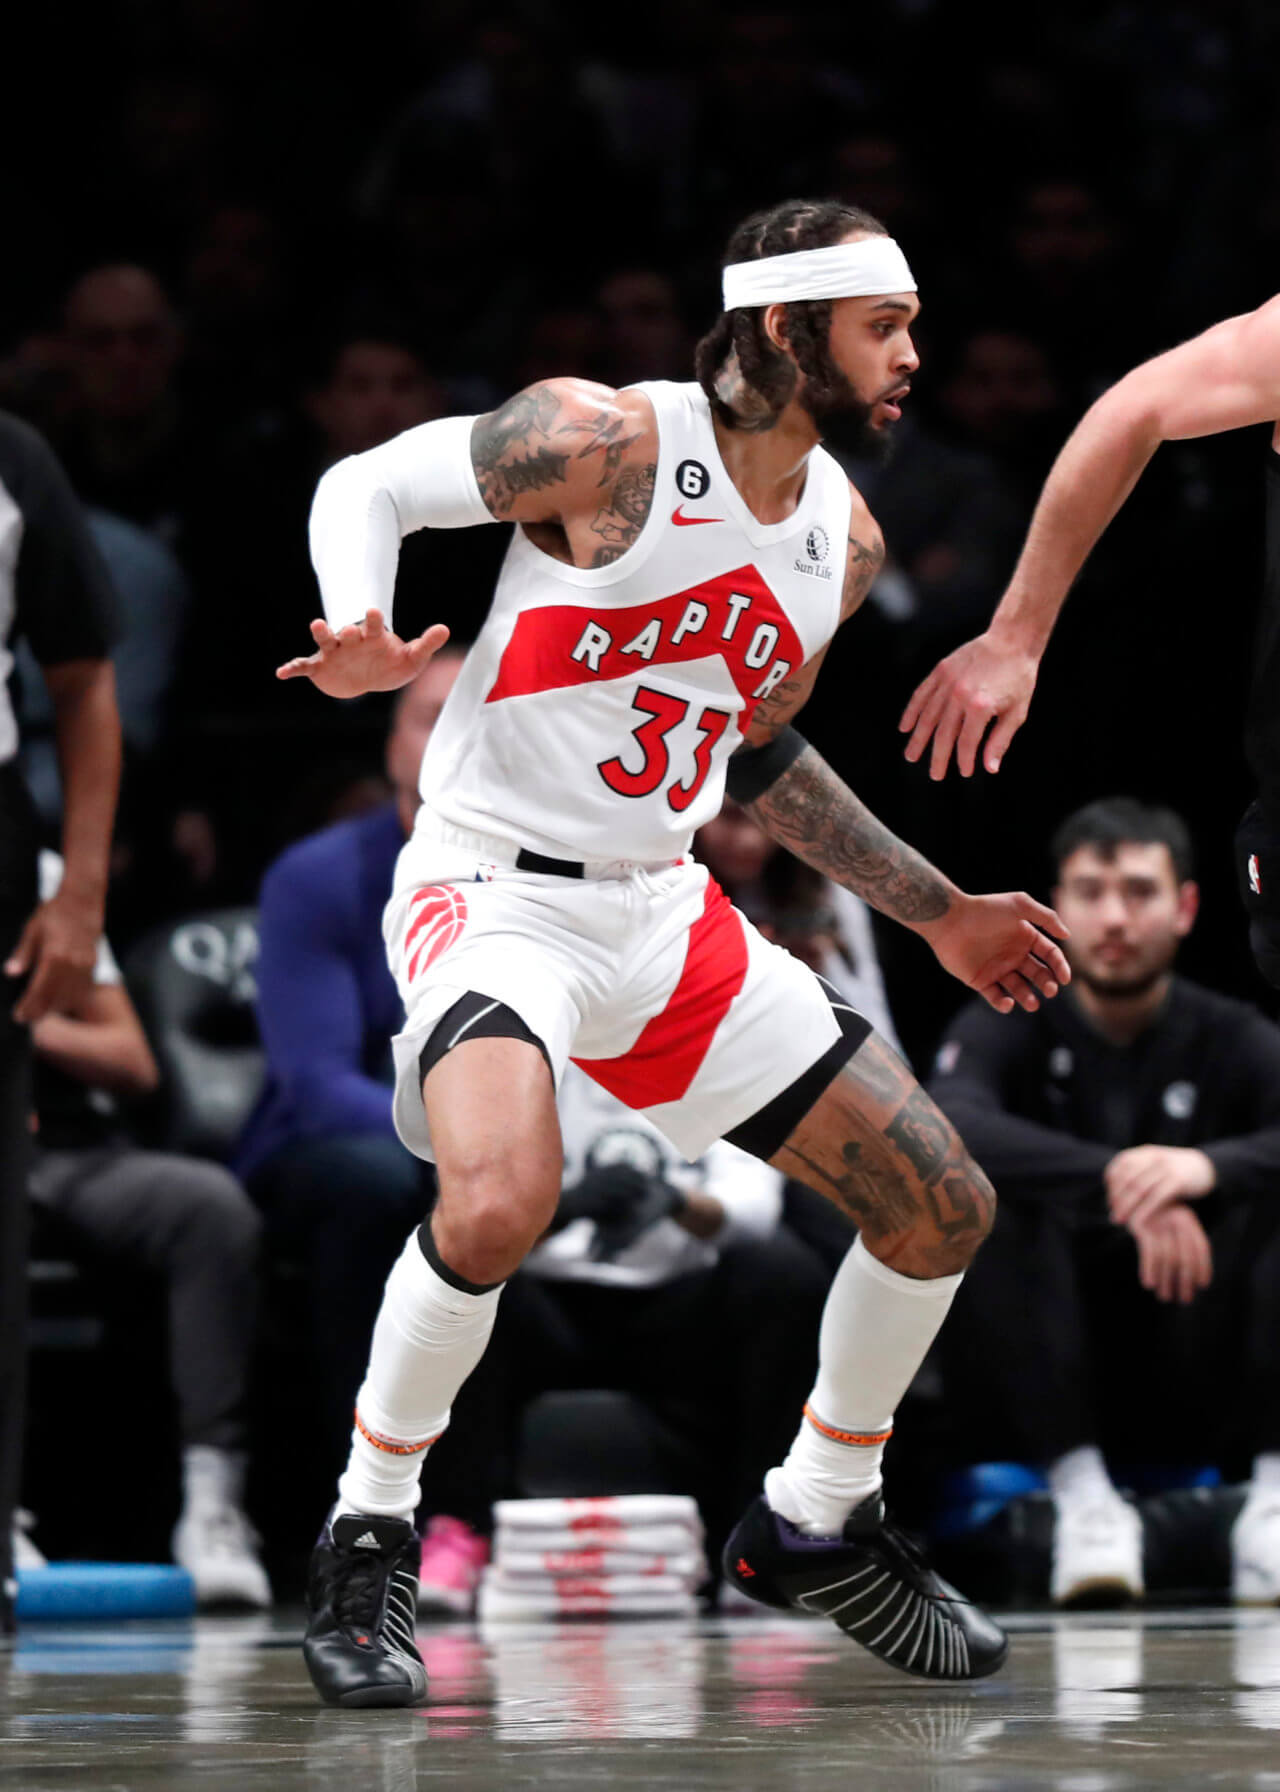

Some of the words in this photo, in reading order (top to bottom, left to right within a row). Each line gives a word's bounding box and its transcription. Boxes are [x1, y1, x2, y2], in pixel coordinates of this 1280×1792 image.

[682, 464, 703, 495] 6
[793, 559, 814, 576] Sun
[815, 564, 833, 580] Life
[597, 685, 731, 813] 33
